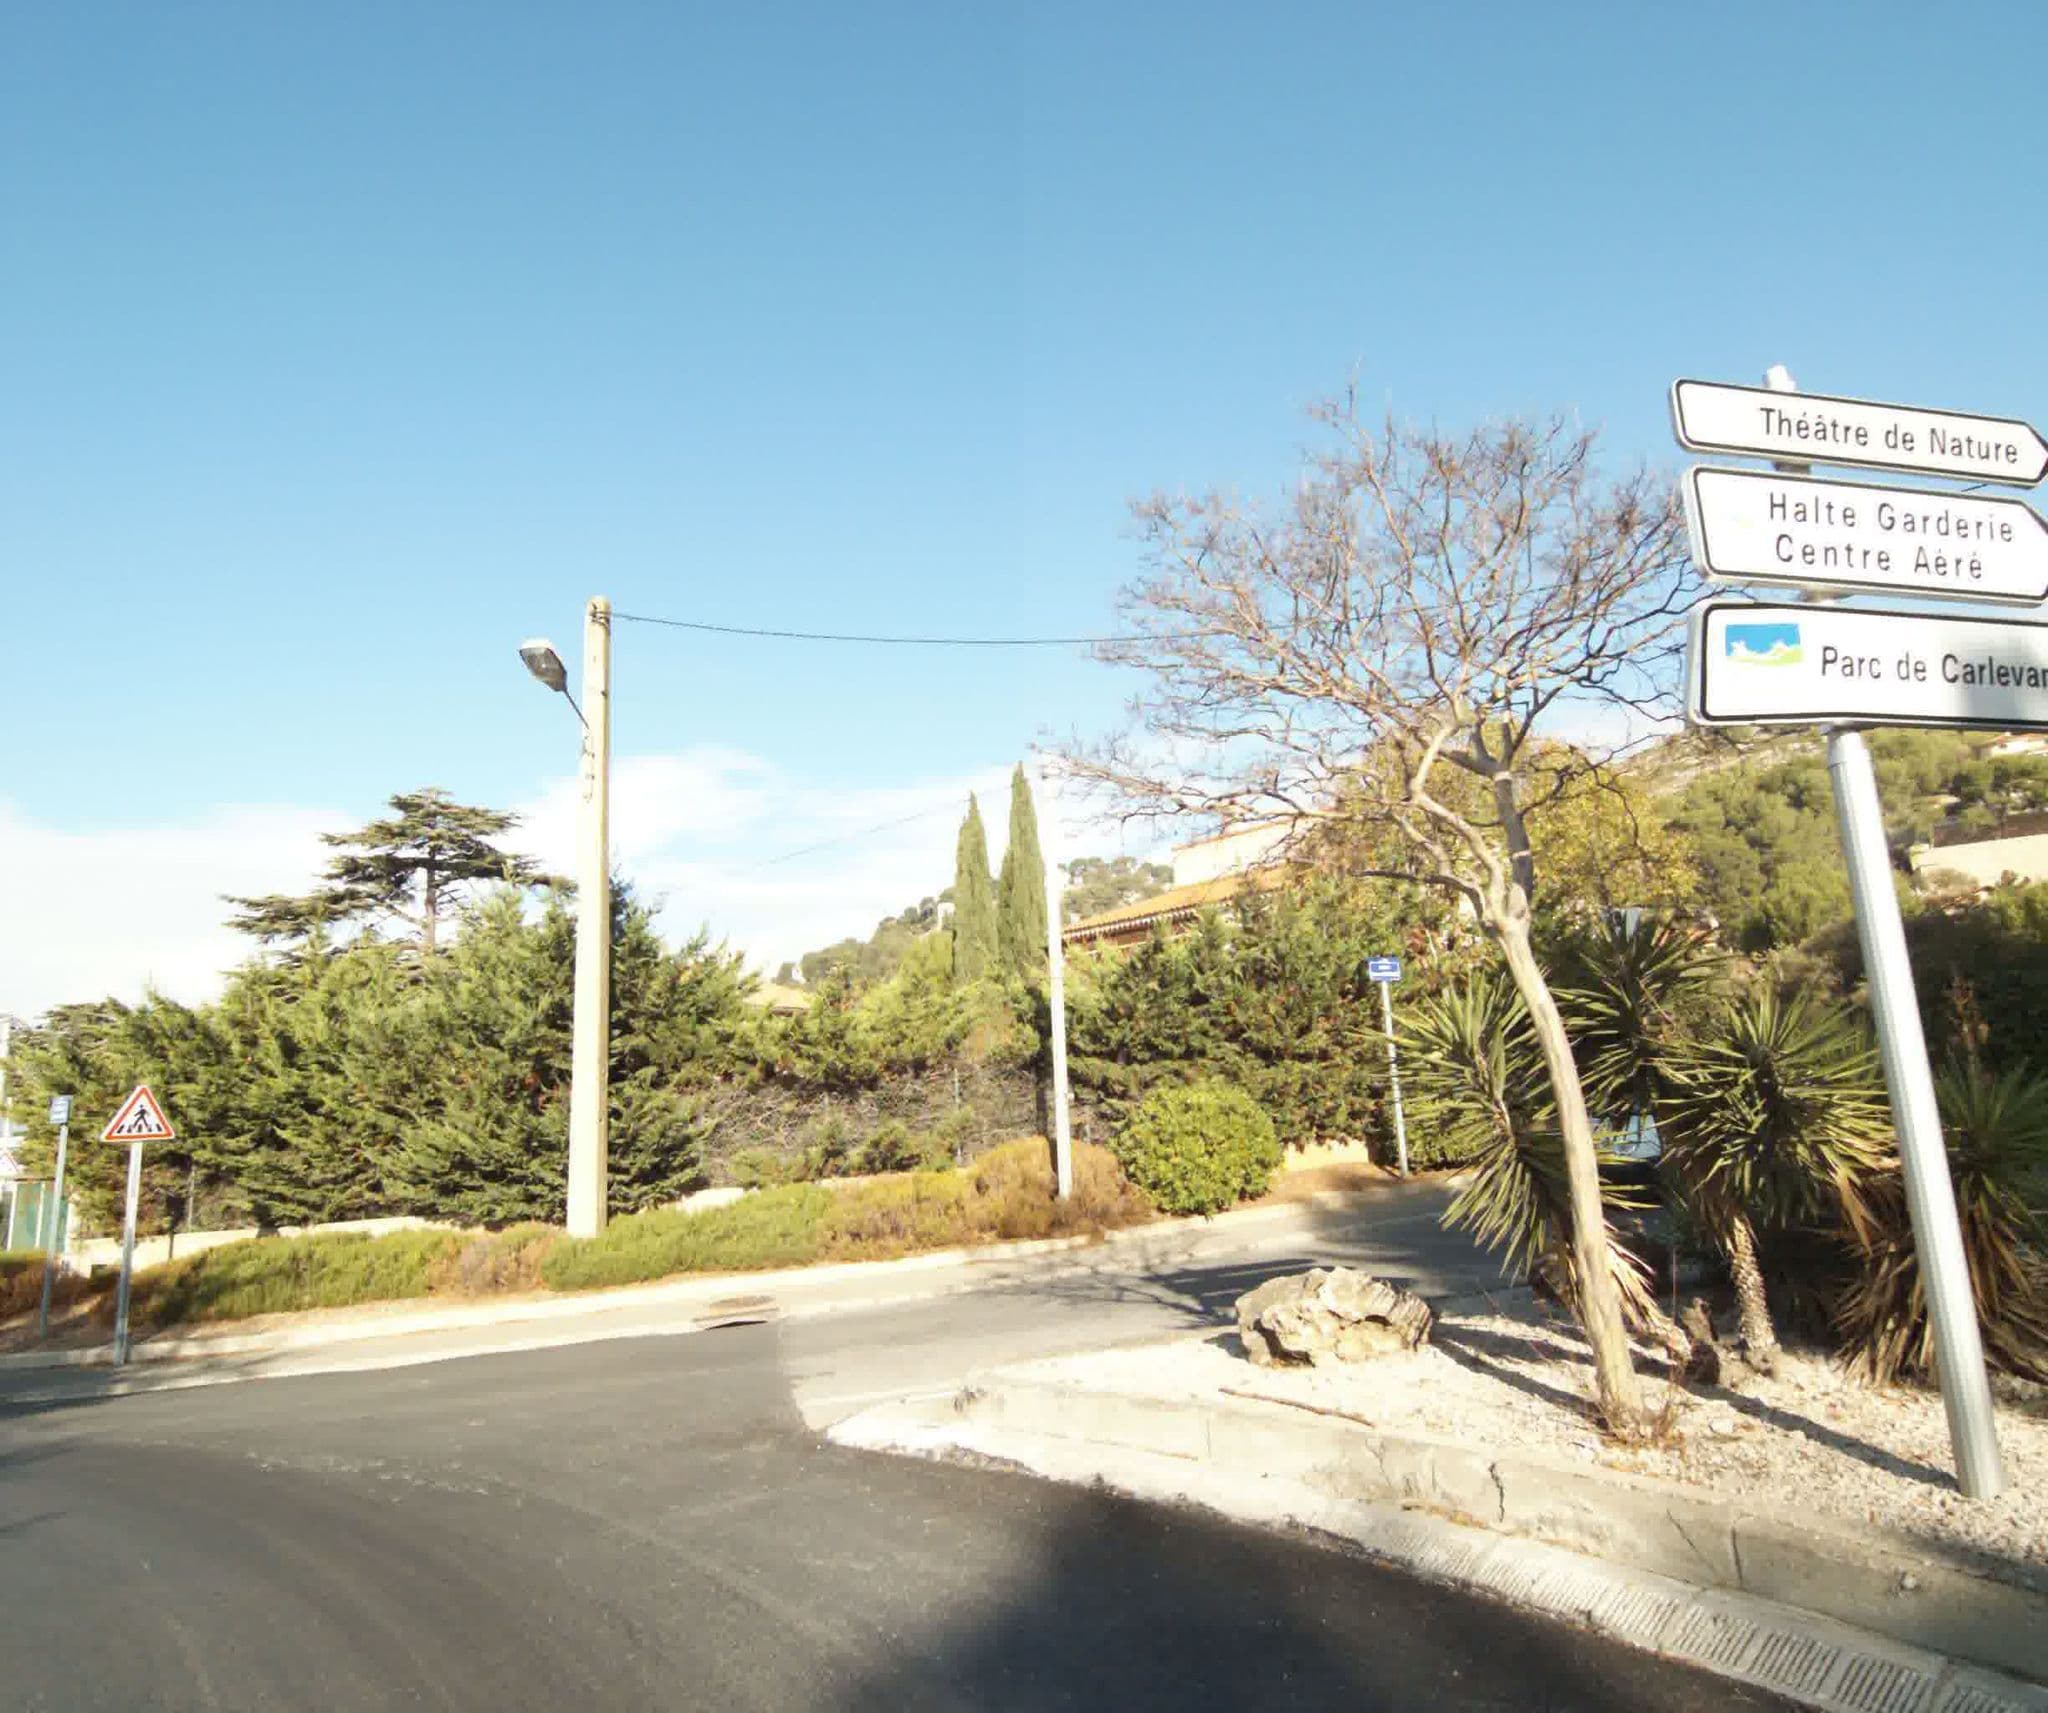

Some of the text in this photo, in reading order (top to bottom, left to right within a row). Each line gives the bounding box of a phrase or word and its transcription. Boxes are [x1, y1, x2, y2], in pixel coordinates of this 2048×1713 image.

[1760, 407, 2018, 464] Théâtre de Nature
[1769, 492, 2013, 543] Halte Garderie
[1776, 534, 1982, 580] Centre Aéré
[1821, 646, 1881, 680] Parc
[1897, 652, 1928, 683] de
